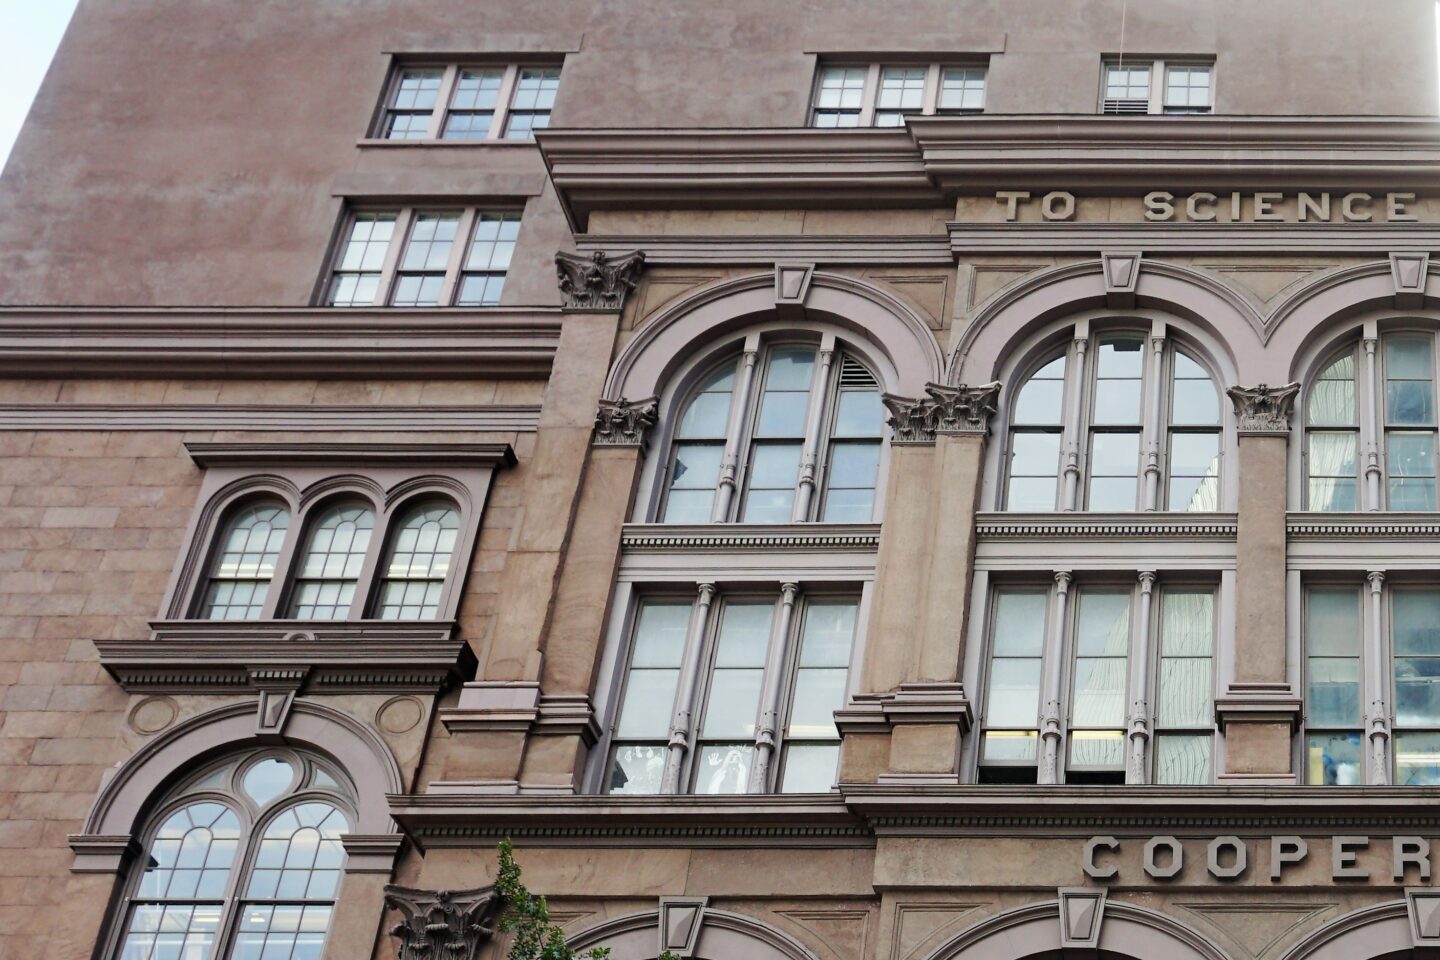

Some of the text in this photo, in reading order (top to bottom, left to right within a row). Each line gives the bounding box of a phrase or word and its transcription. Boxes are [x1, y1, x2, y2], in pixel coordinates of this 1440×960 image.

[996, 191, 1076, 222] TO
[1143, 191, 1419, 223] SCIENCE
[1082, 835, 1433, 882] COOPER
